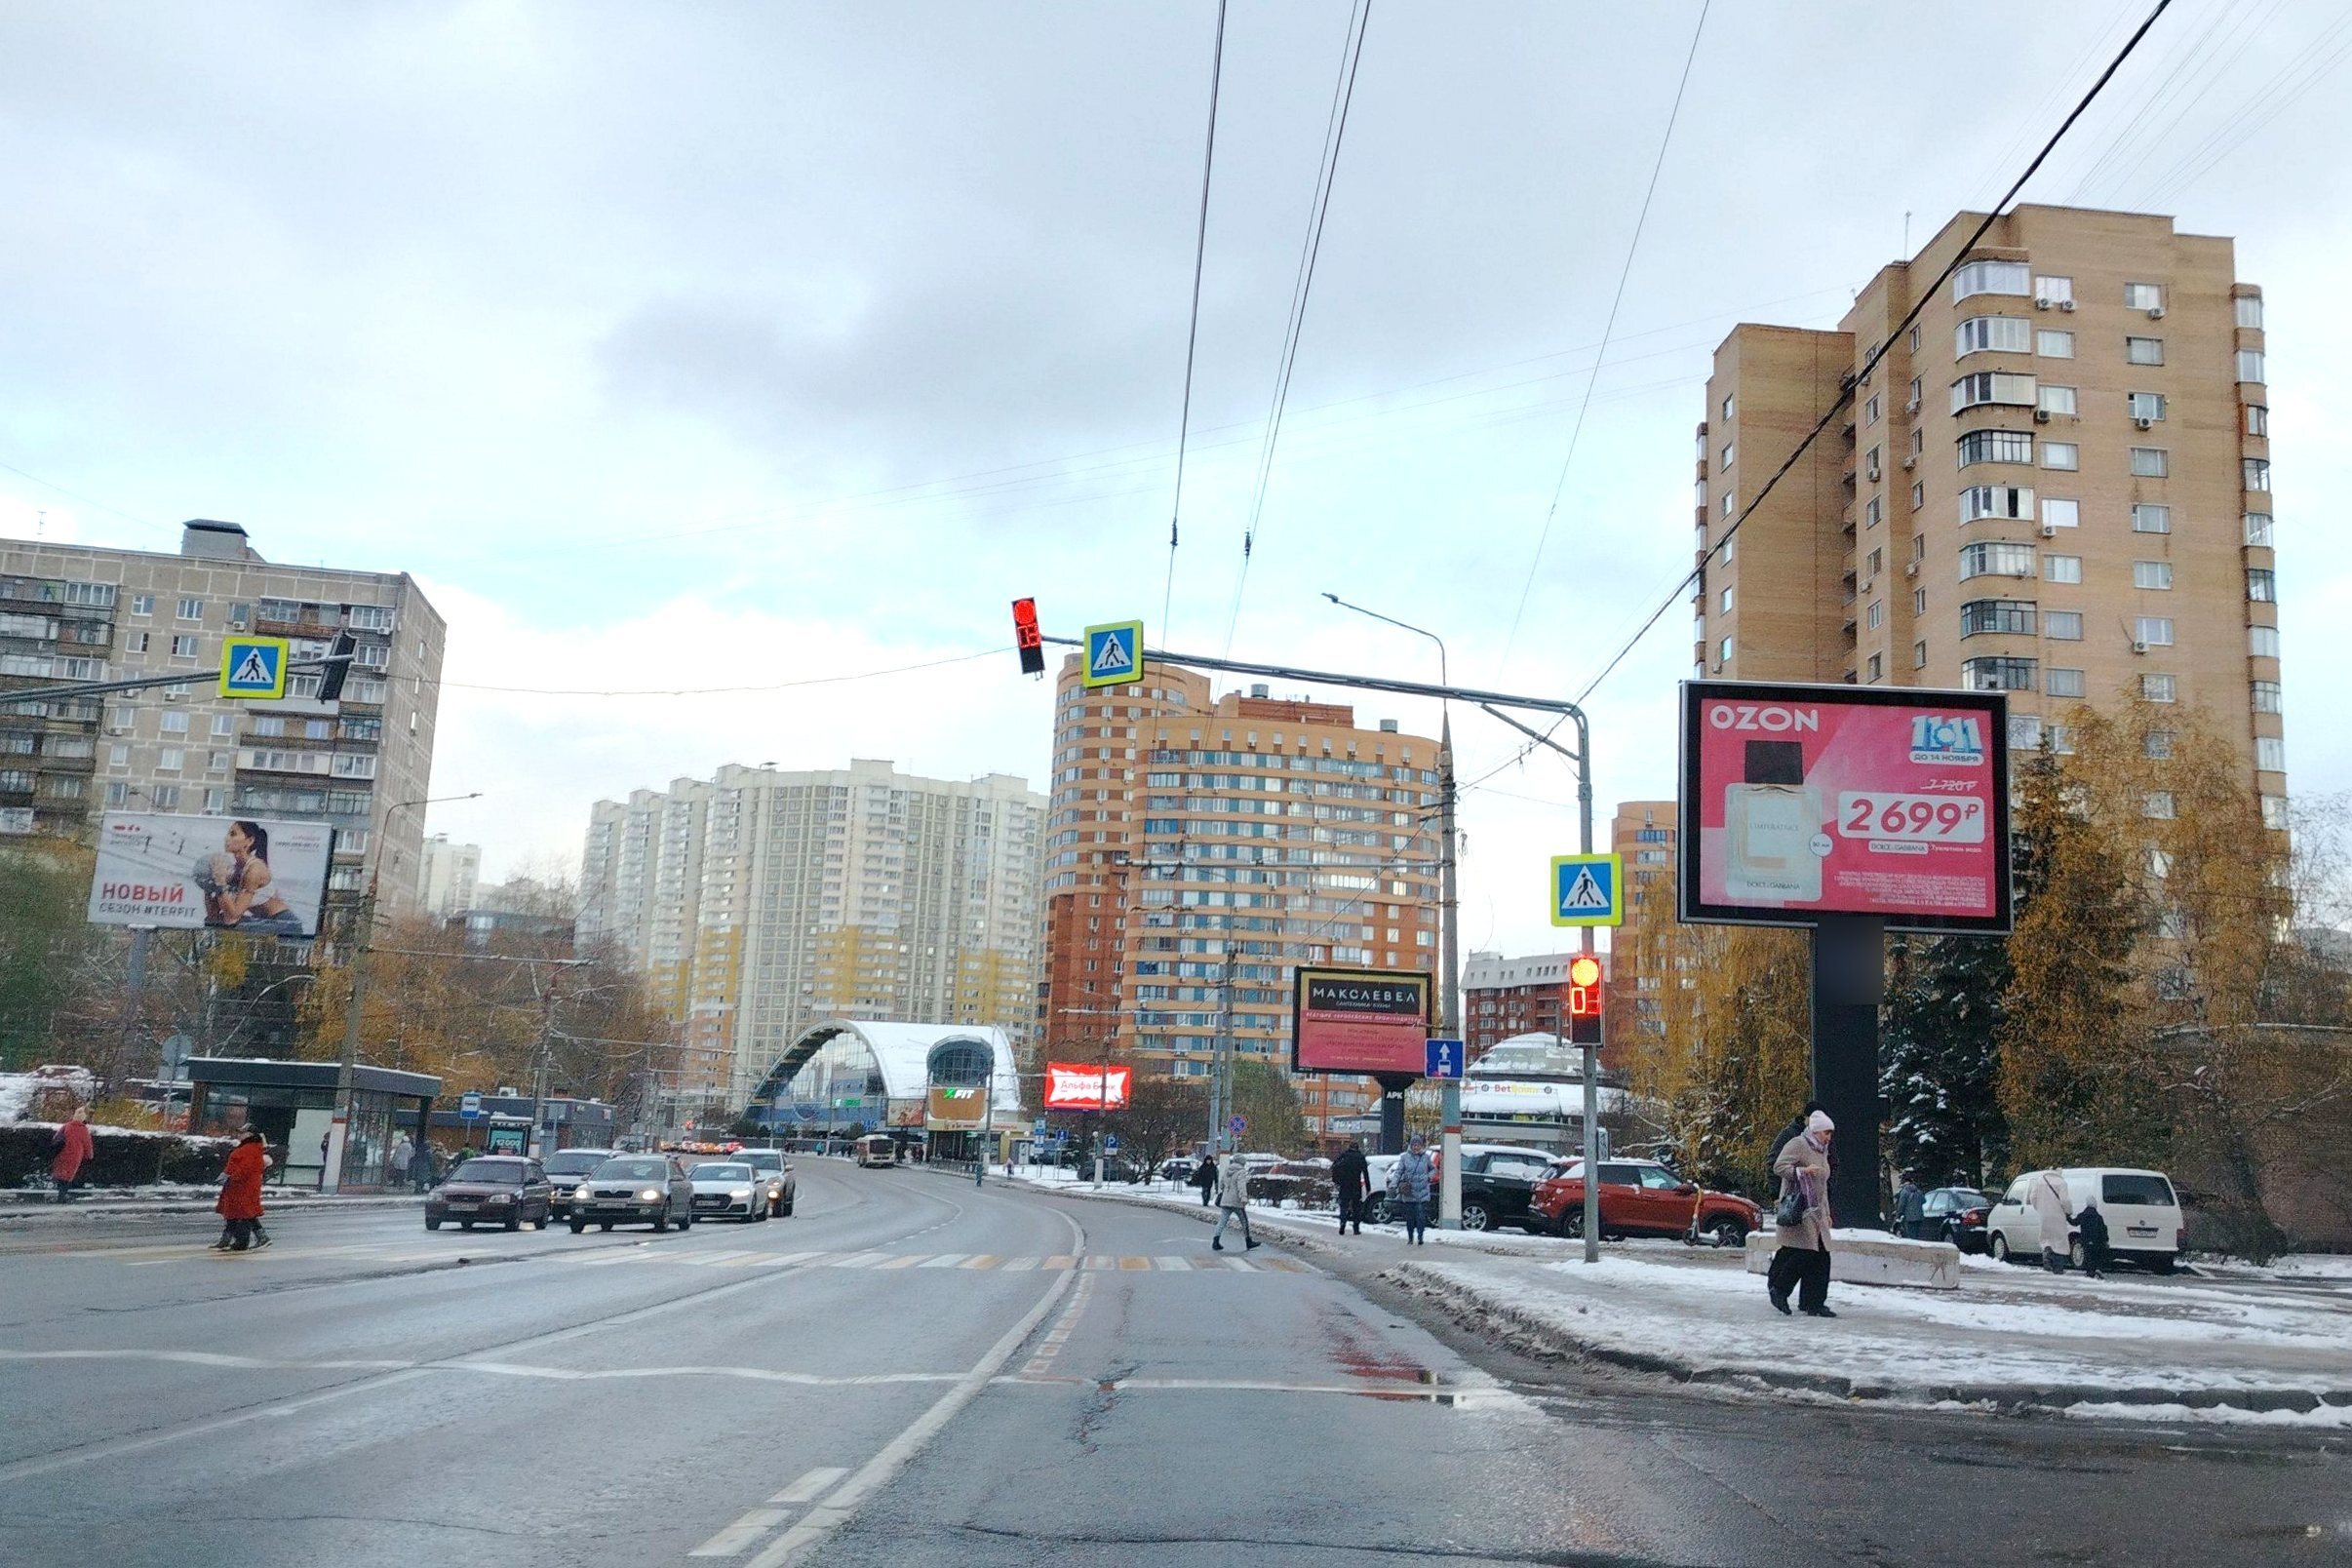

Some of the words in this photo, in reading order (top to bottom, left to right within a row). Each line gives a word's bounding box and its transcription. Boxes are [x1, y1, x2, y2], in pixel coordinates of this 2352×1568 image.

[1709, 704, 1819, 732] OZON
[101, 882, 185, 903] НОВЫЙ
[98, 902, 142, 915] СЕЗОН
[1061, 1080, 1091, 1090] Альфа
